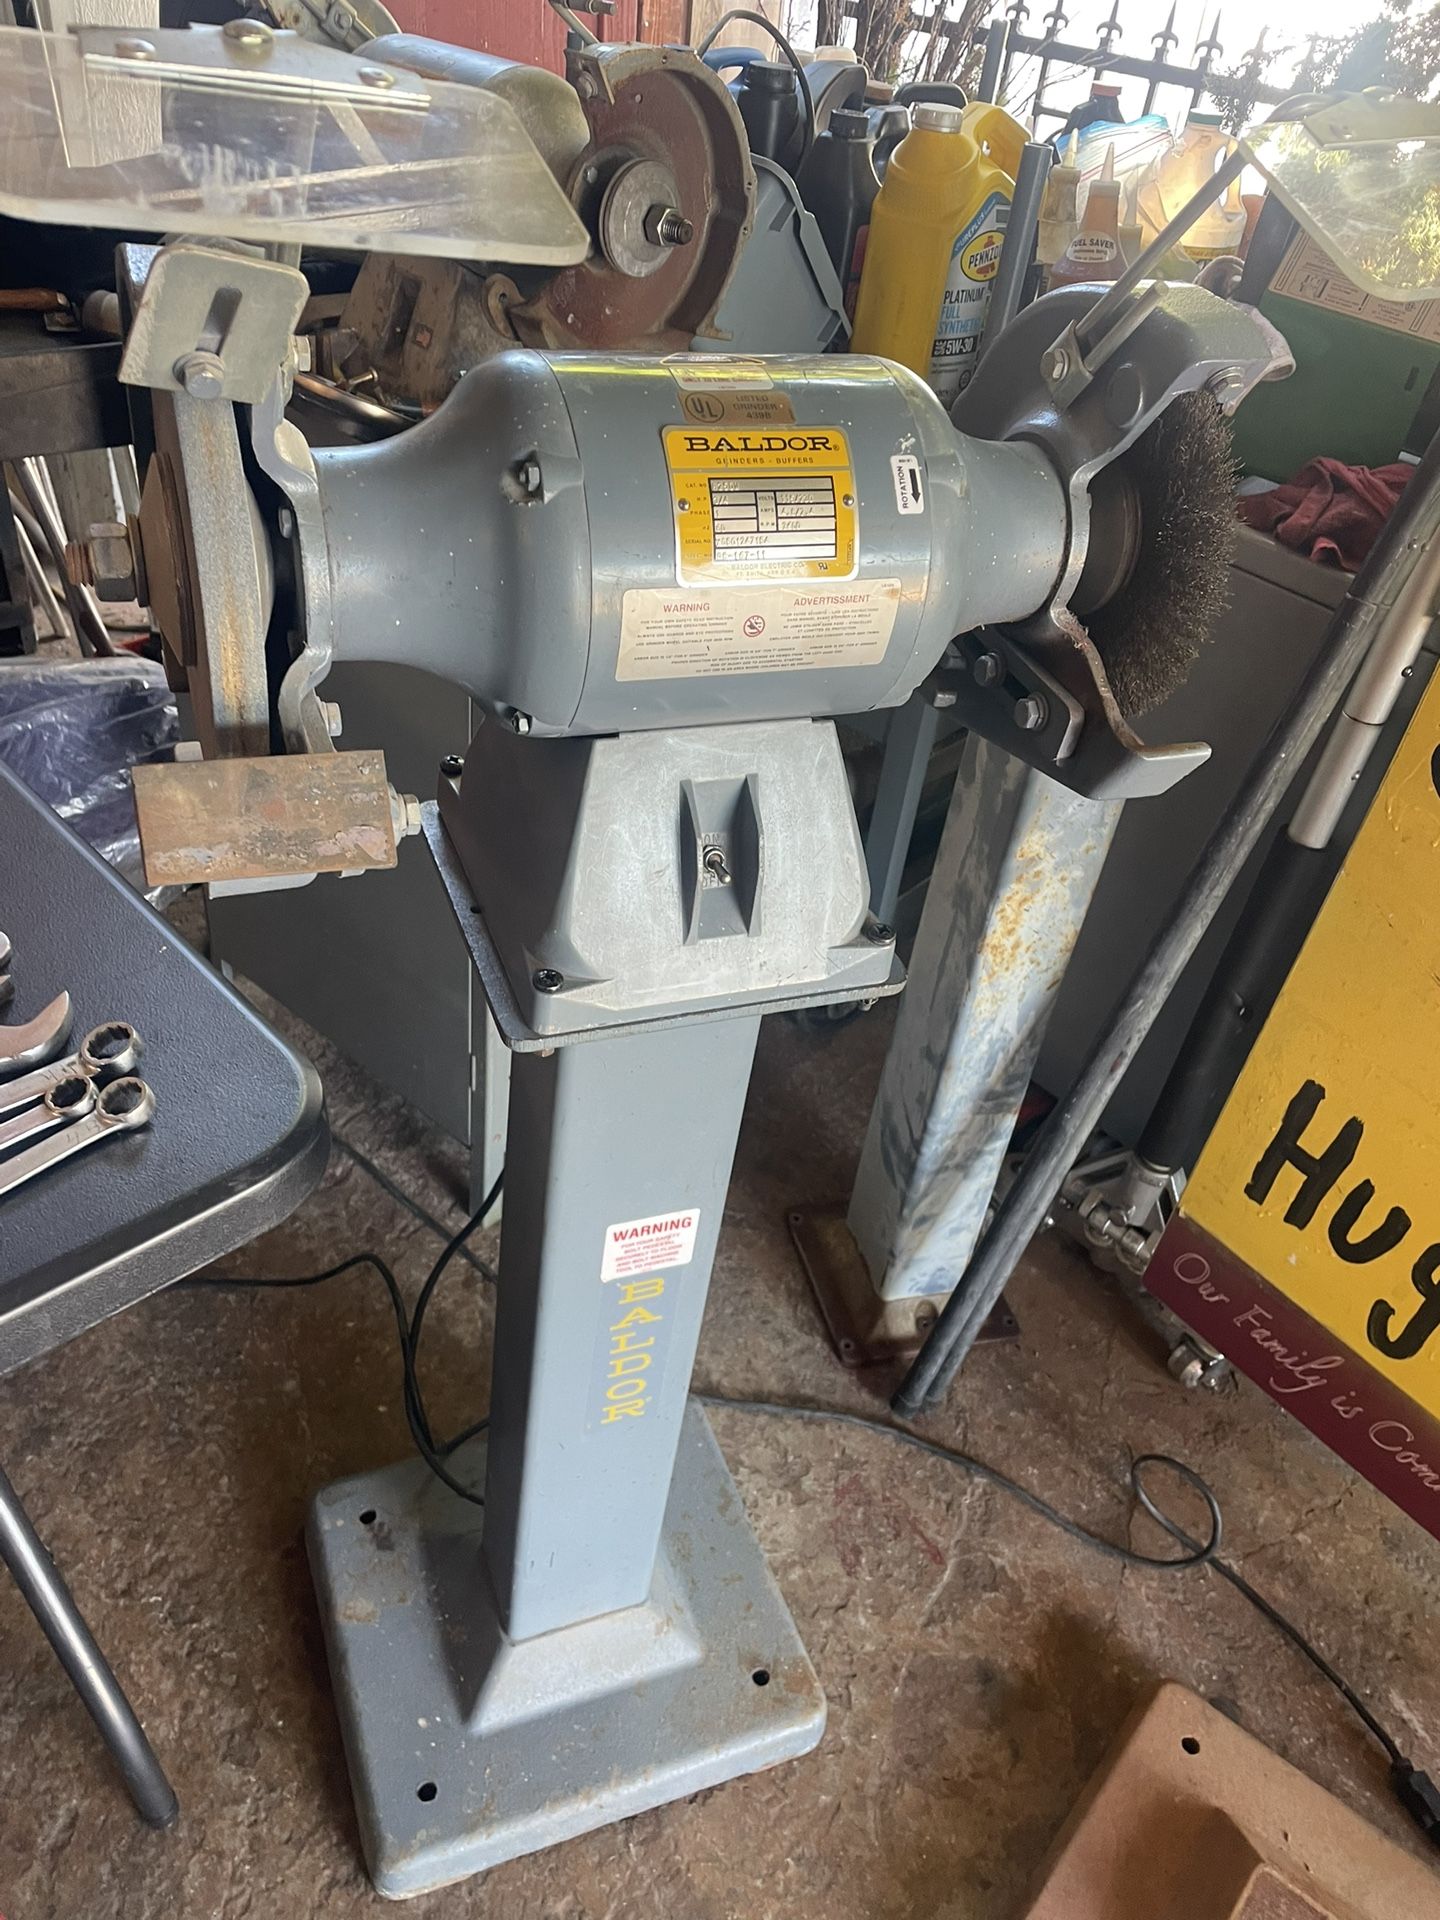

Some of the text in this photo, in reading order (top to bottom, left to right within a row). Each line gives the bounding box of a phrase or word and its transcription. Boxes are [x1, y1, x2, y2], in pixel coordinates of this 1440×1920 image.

[1089, 238, 1115, 249] SAVER
[944, 287, 985, 304] PLATINUM
[942, 305, 960, 319] FULL
[946, 337, 974, 354] 5W-30
[776, 456, 814, 464] BUFFERS
[896, 466, 909, 509] ROTATION
[663, 602, 710, 614] WARNING
[793, 594, 871, 607] ADVERTISSMENT
[613, 1217, 692, 1242] WARNING
[1173, 1252, 1230, 1304] Our
[1234, 1303, 1346, 1393] Family
[1331, 1391, 1364, 1420] is
[600, 1278, 665, 1424] BALDOR
